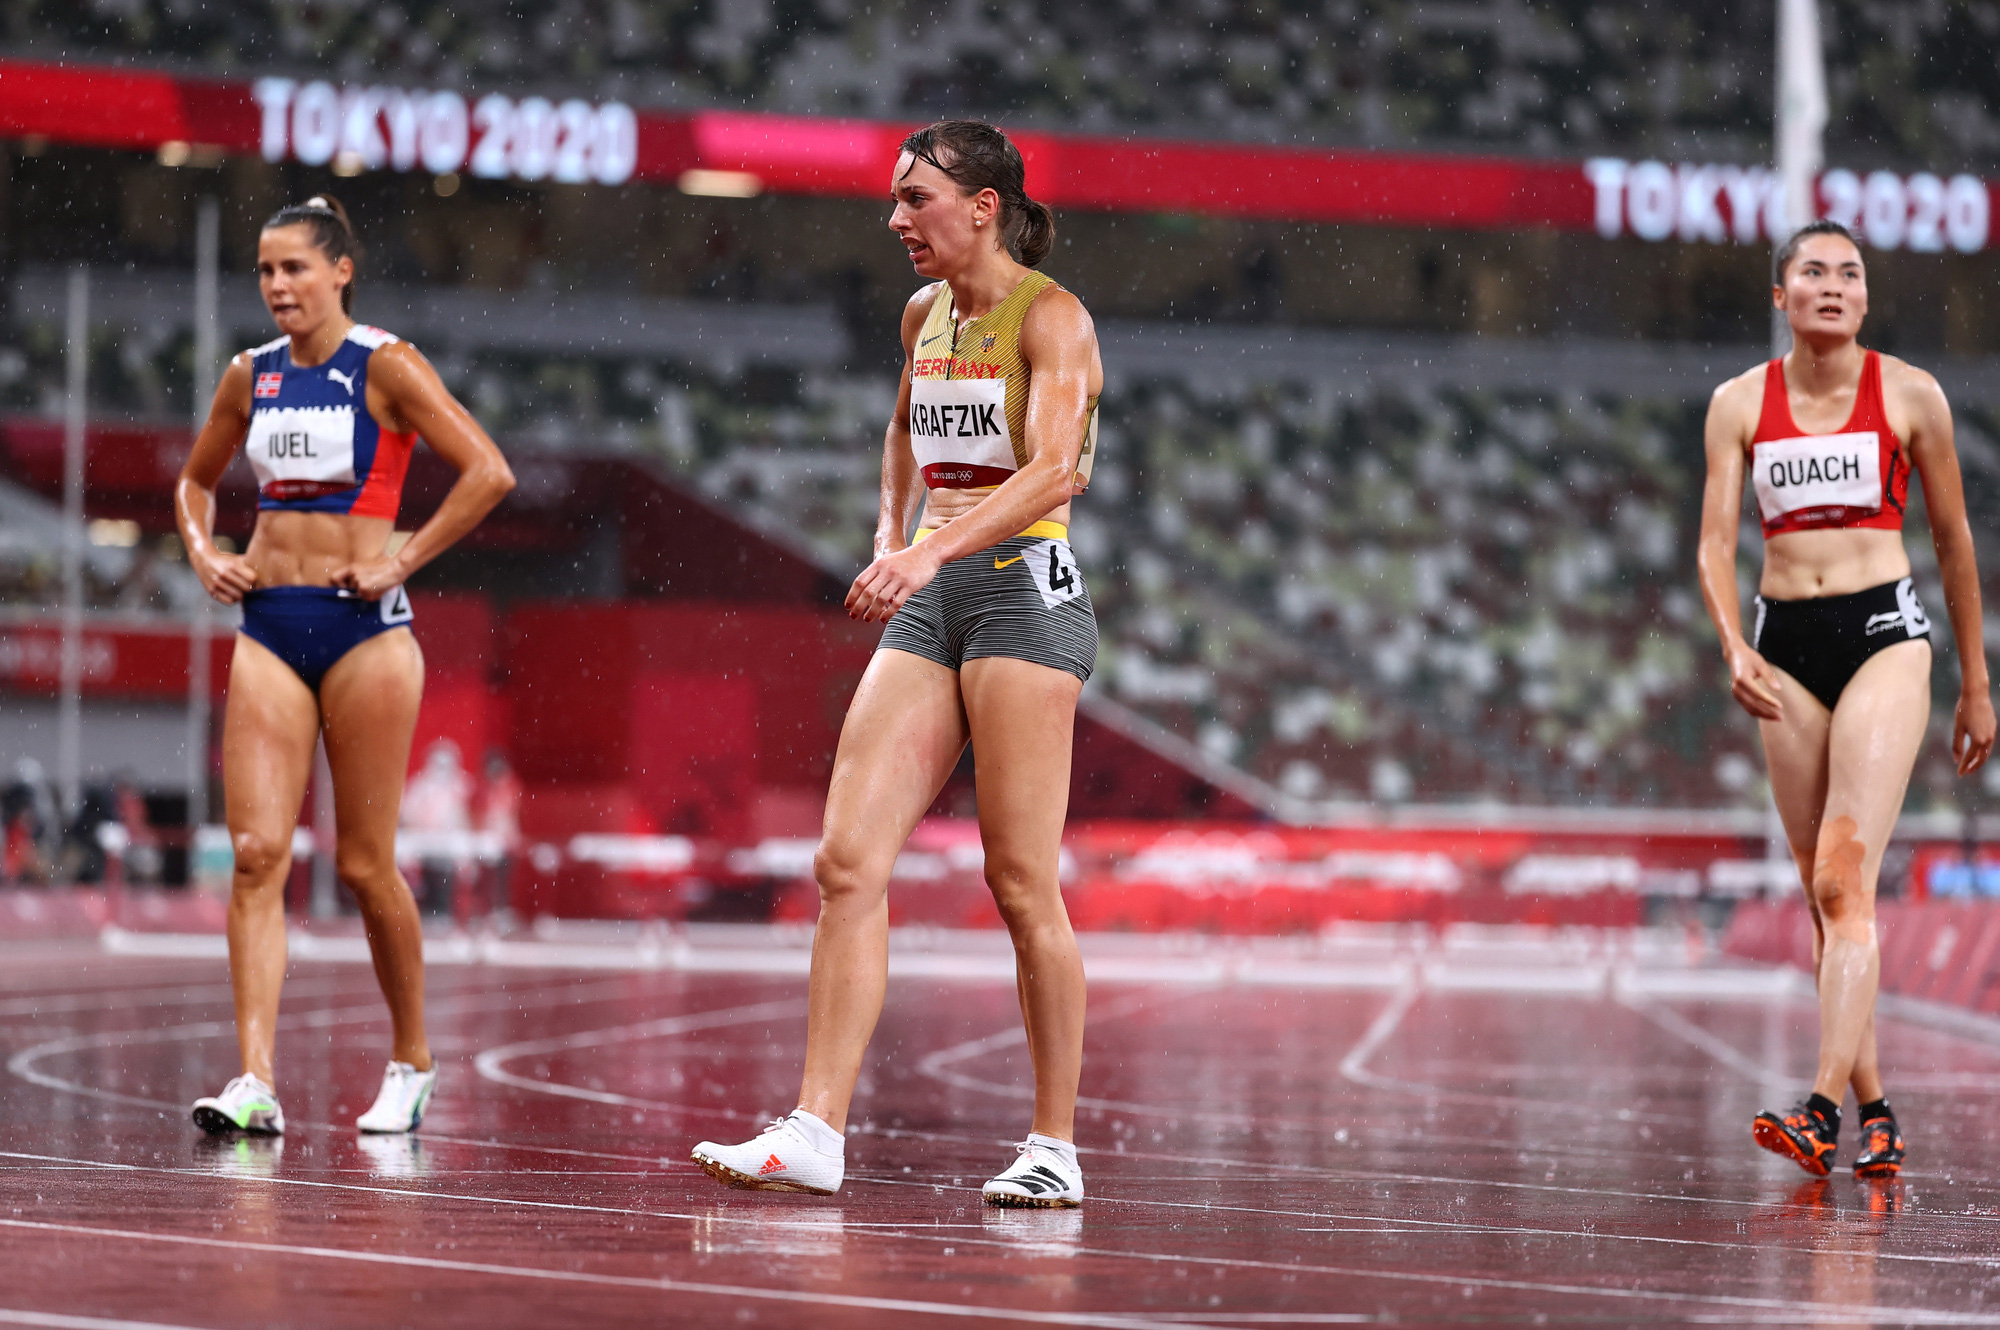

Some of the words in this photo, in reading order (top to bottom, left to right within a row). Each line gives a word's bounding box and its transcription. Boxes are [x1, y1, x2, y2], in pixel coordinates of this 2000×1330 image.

[252, 76, 470, 175] TOKYO
[470, 94, 638, 187] 2020
[1819, 167, 1990, 255] 2020
[914, 357, 1001, 379] GERMANY
[911, 403, 1002, 438] KRAFZIK
[269, 432, 317, 459] IUEL
[1770, 454, 1860, 488] QUACH
[1049, 545, 1074, 594] 4
[758, 1164, 788, 1176] adidas
